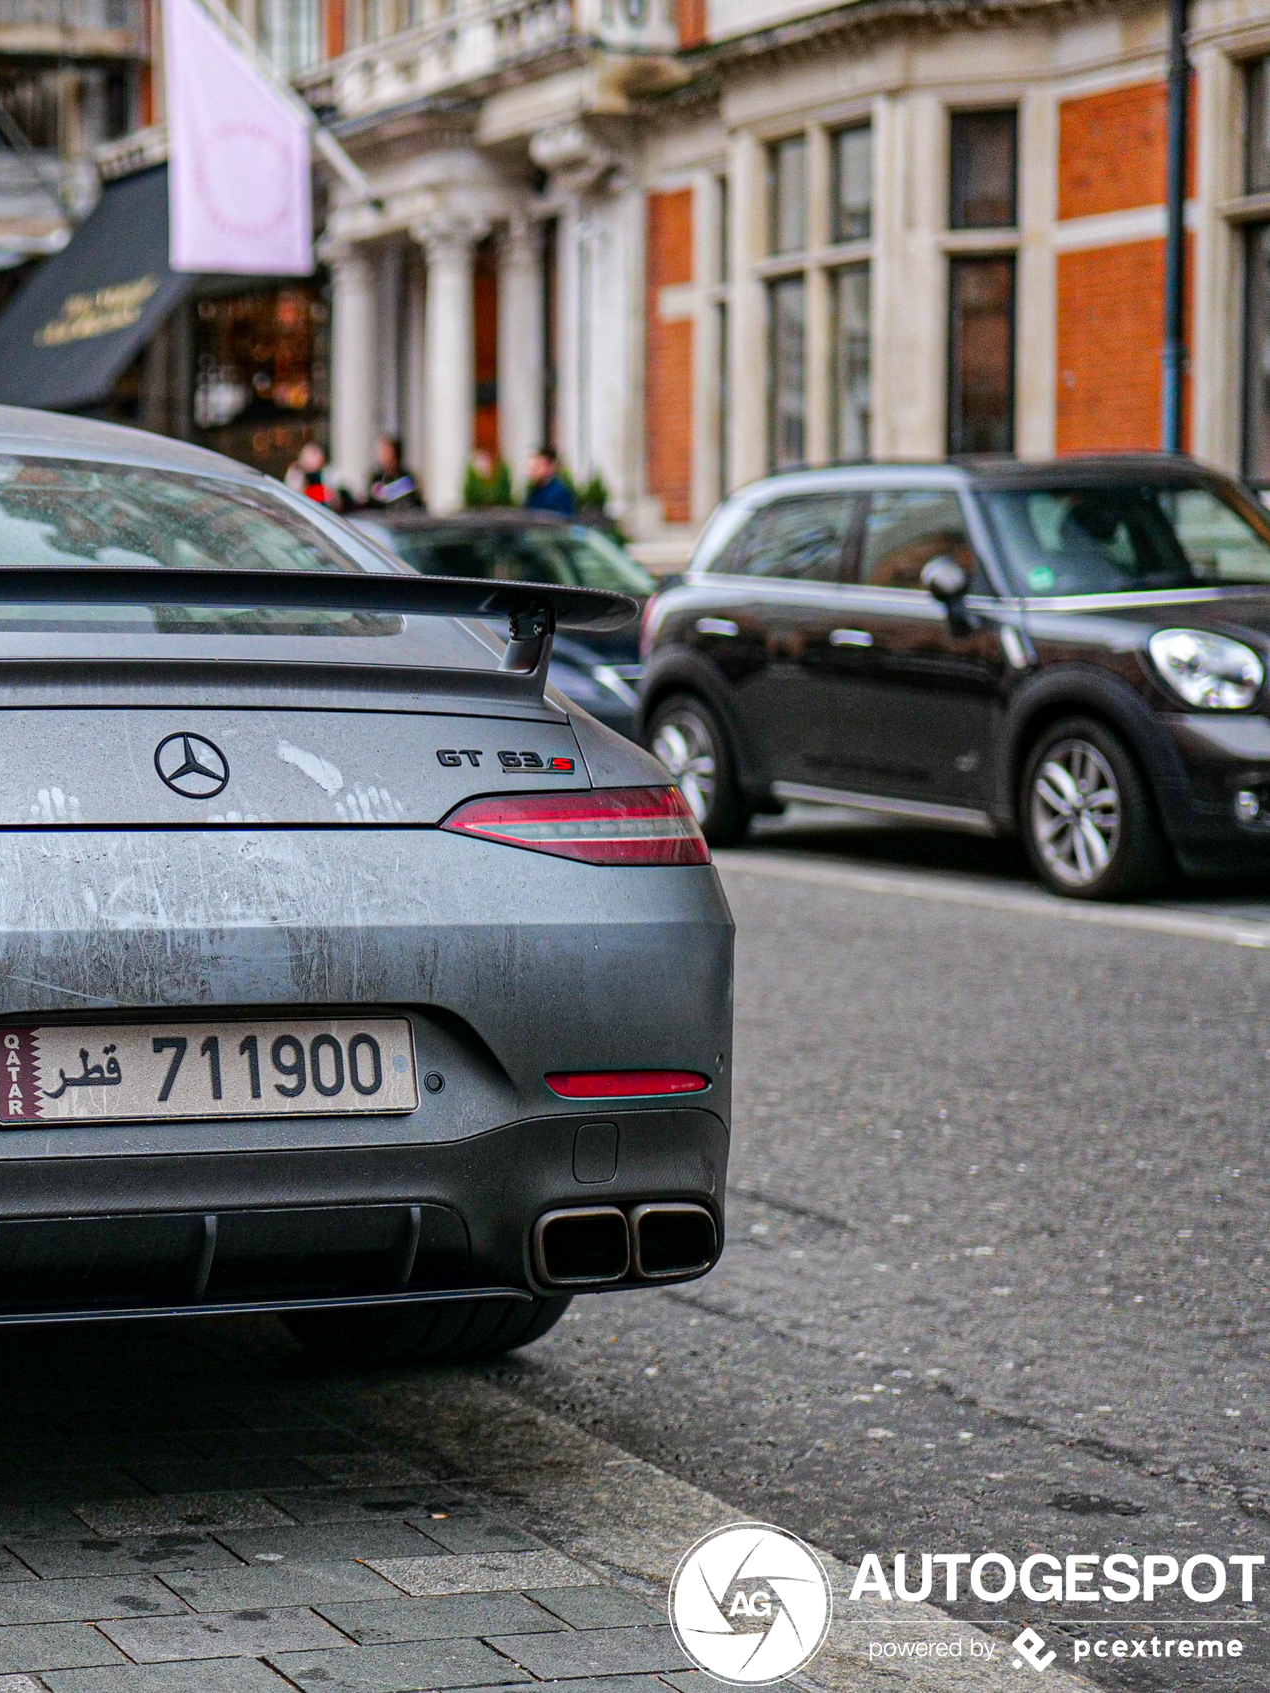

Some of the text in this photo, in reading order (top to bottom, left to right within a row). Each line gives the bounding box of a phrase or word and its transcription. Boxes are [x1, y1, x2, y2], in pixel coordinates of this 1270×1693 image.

[436, 749, 483, 767] GT
[3, 1033, 24, 1116] QATAR
[42, 1043, 122, 1099] قطر
[152, 1032, 383, 1101] 711900
